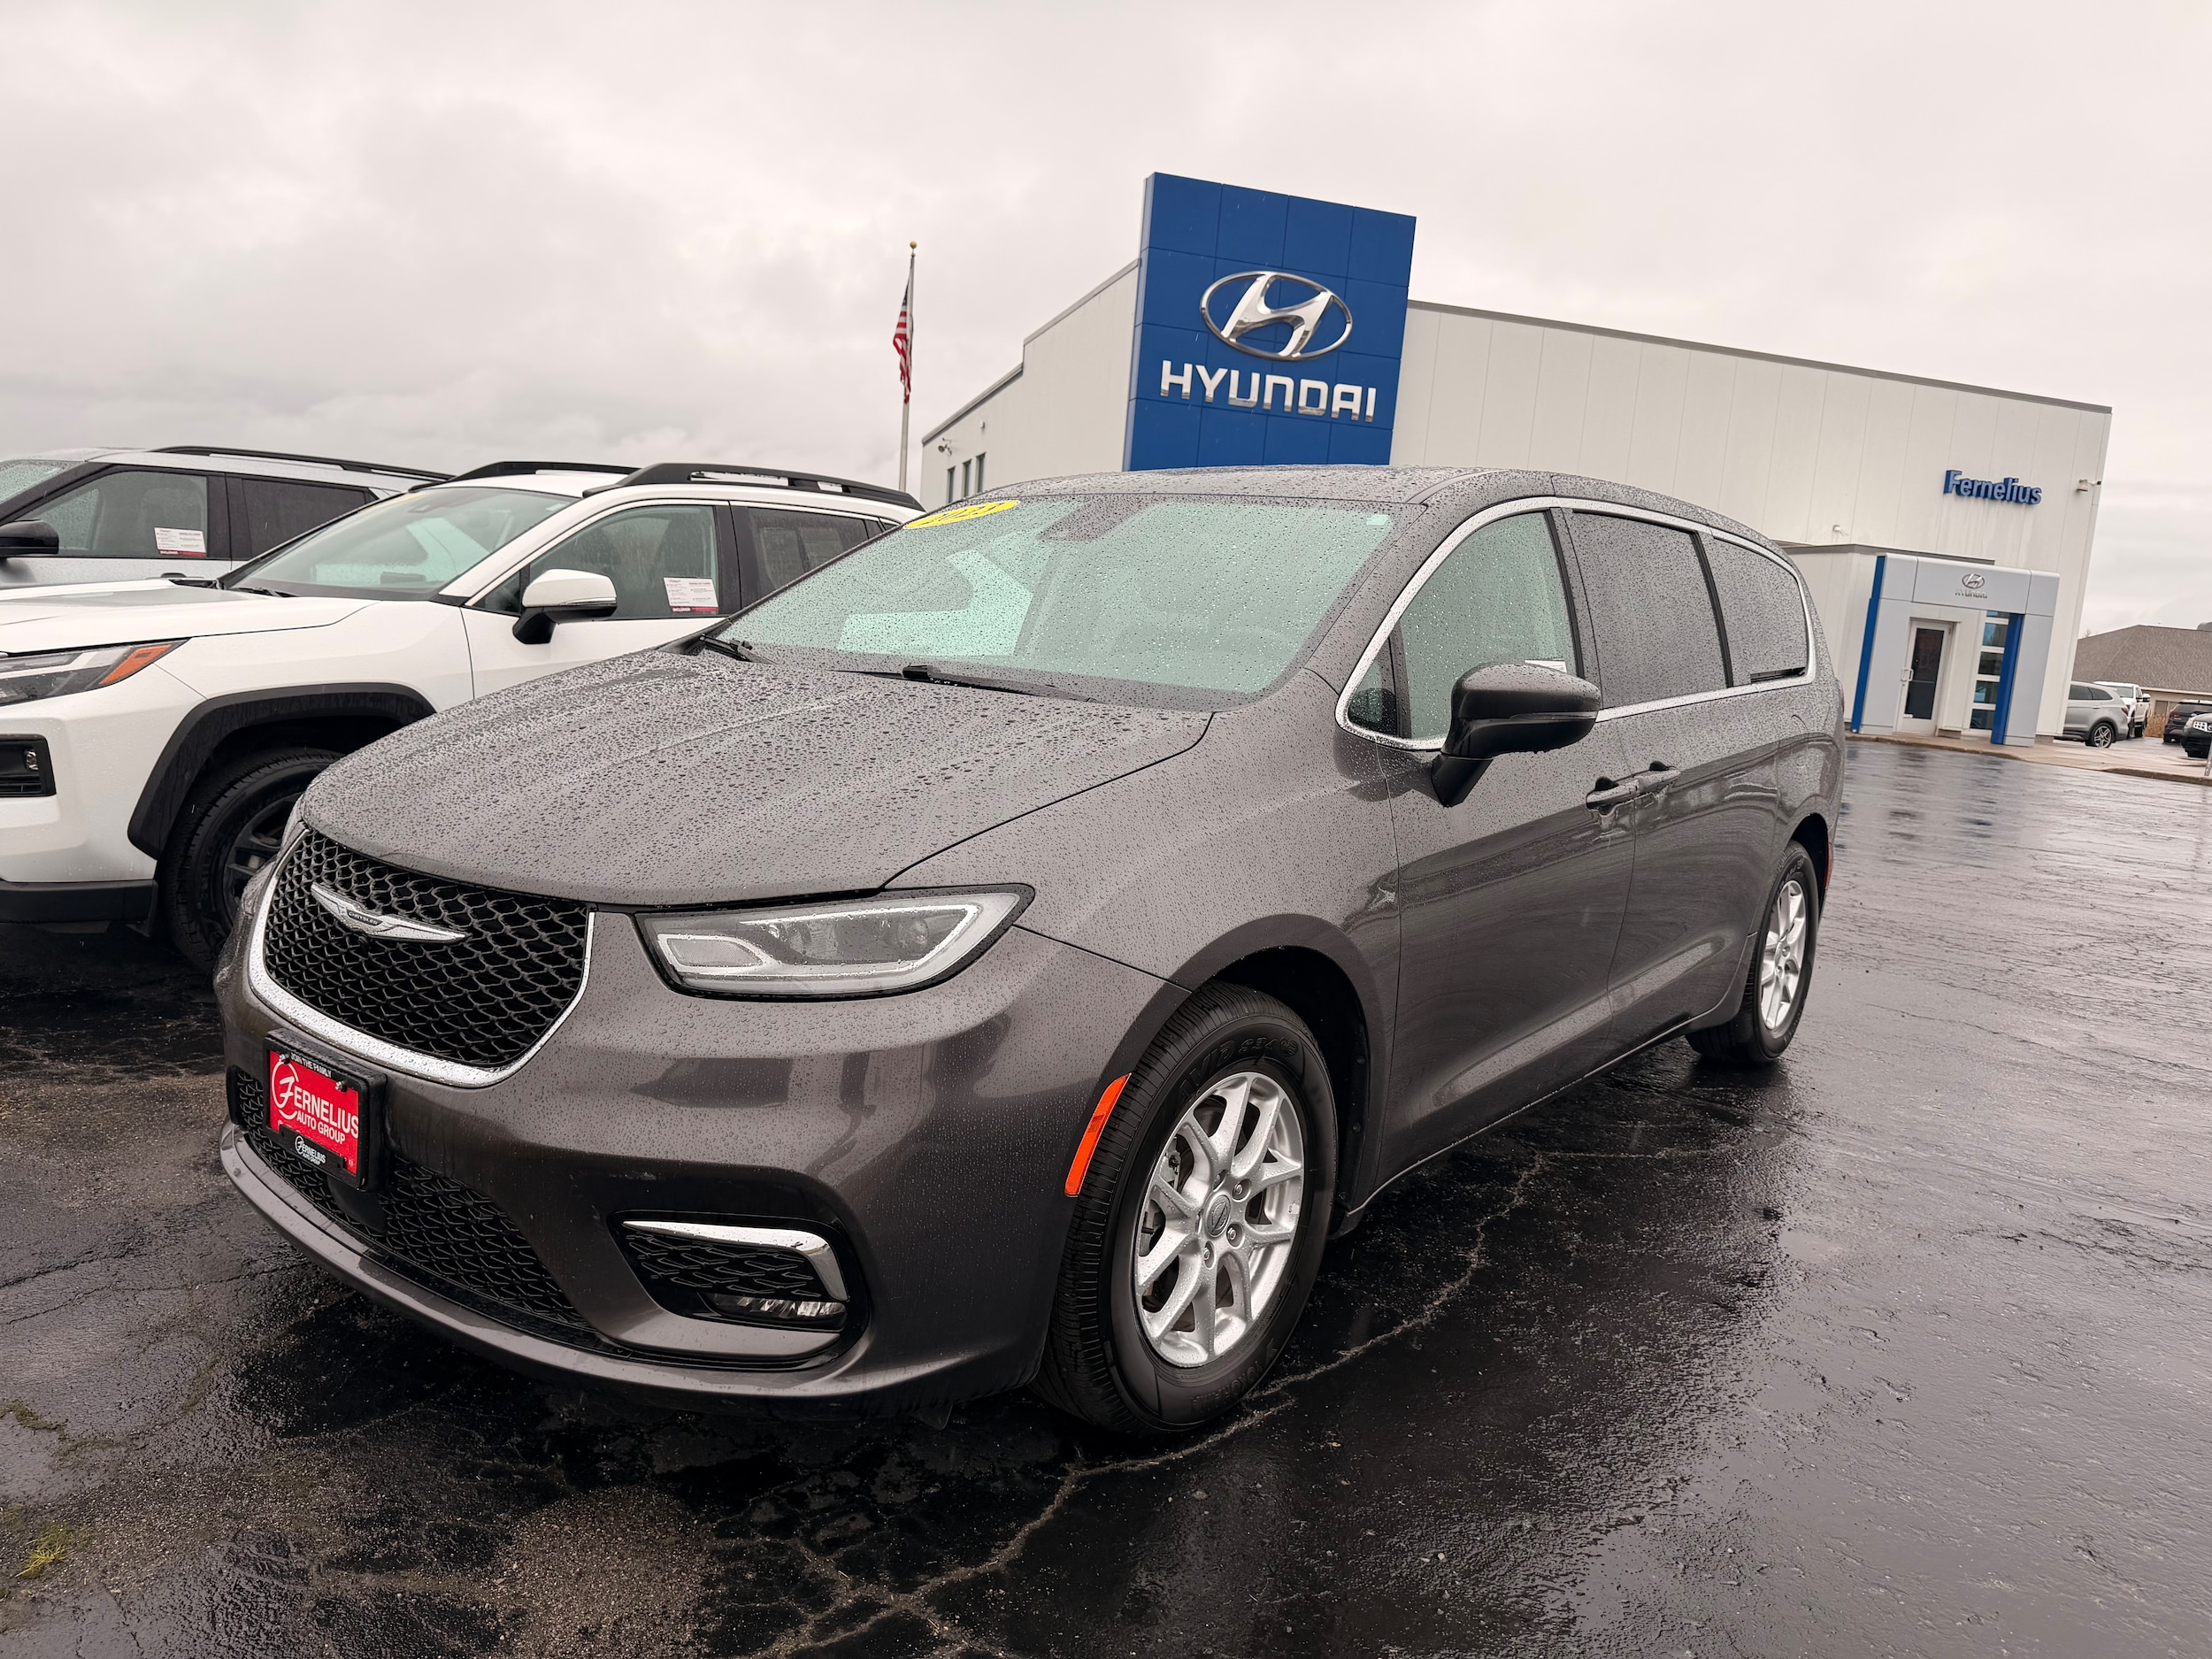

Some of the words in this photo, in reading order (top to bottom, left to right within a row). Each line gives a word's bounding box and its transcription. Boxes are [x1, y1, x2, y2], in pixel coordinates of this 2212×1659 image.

[1160, 359, 1377, 423] HYUNDAI
[1944, 469, 2042, 505] Fernelius
[348, 911, 379, 926] CHRYSLER
[302, 1057, 313, 1070] THE
[312, 1063, 333, 1078] FAMILY
[272, 1061, 359, 1139] FERNELIUS
[296, 1110, 317, 1131] AUTO
[318, 1121, 346, 1145] GROUP
